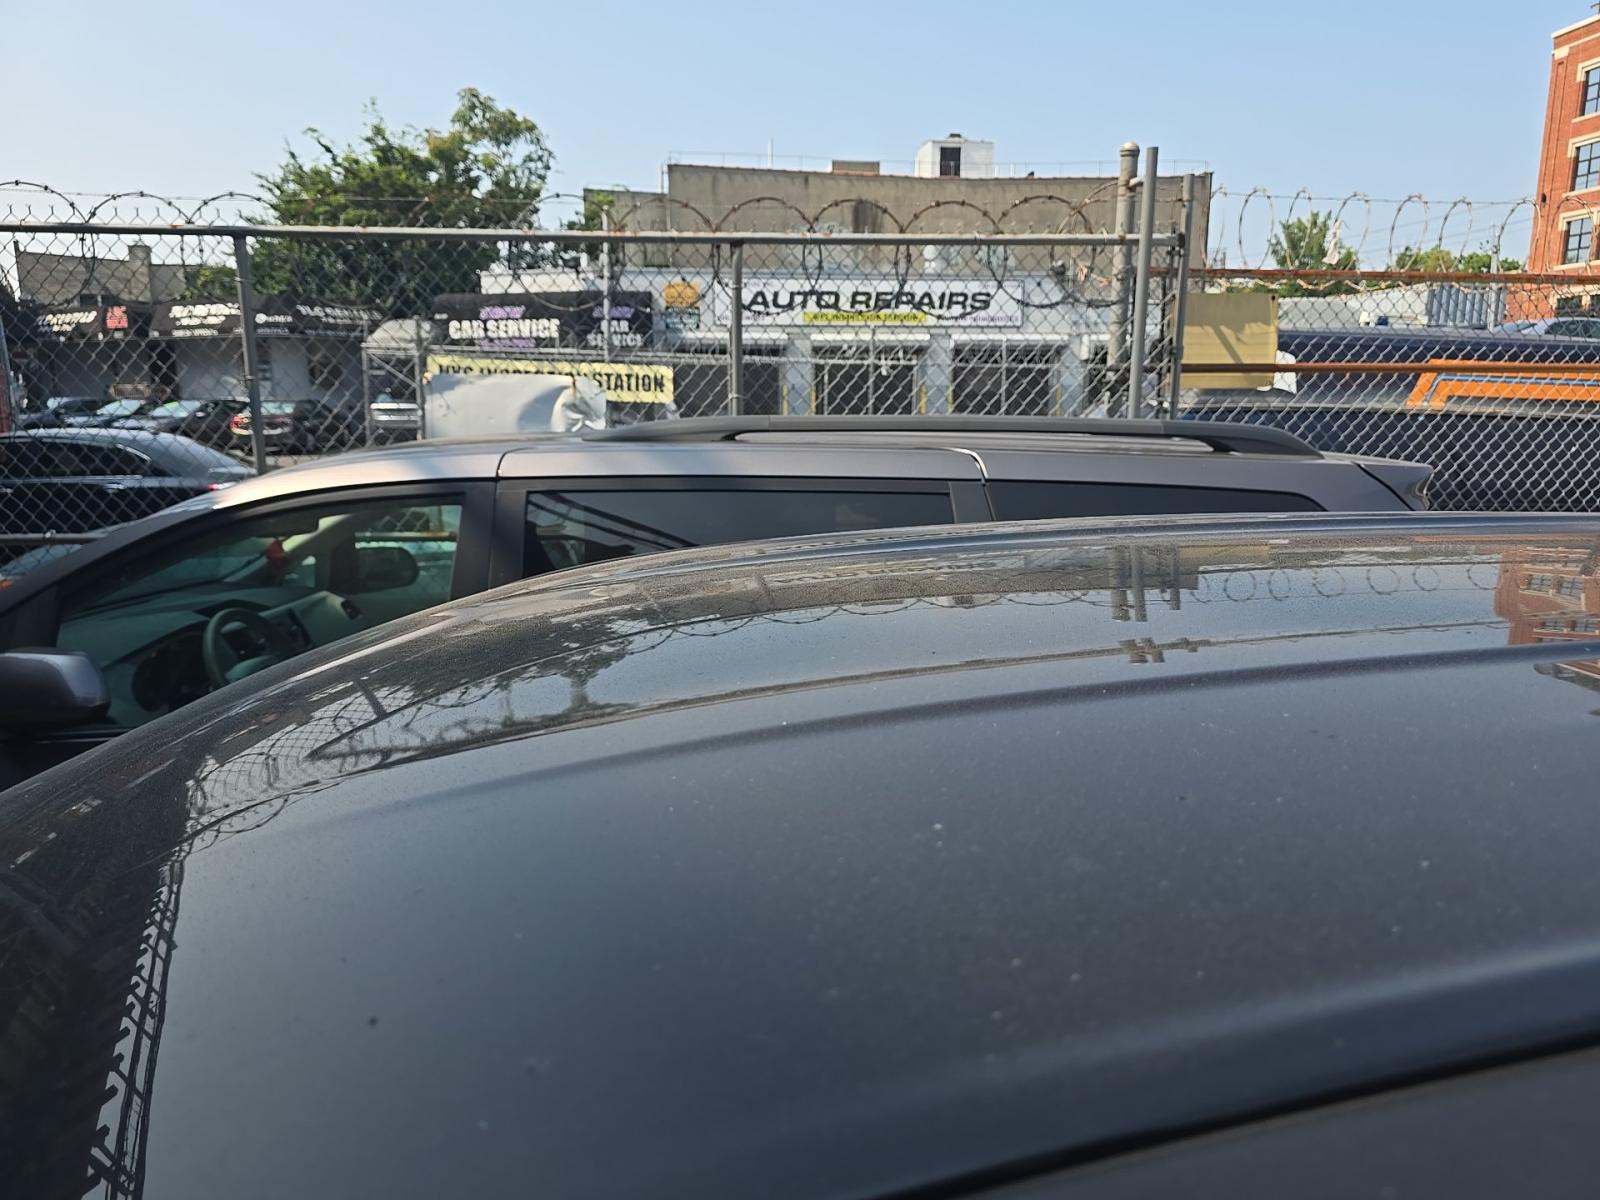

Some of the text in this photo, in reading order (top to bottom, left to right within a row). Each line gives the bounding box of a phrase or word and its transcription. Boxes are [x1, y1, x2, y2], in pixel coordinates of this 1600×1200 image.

[747, 290, 991, 311] AUTO REPAIRS
[448, 319, 559, 339] CAR SERVICE
[586, 333, 644, 347] SEVICE
[593, 372, 666, 393] STATION
